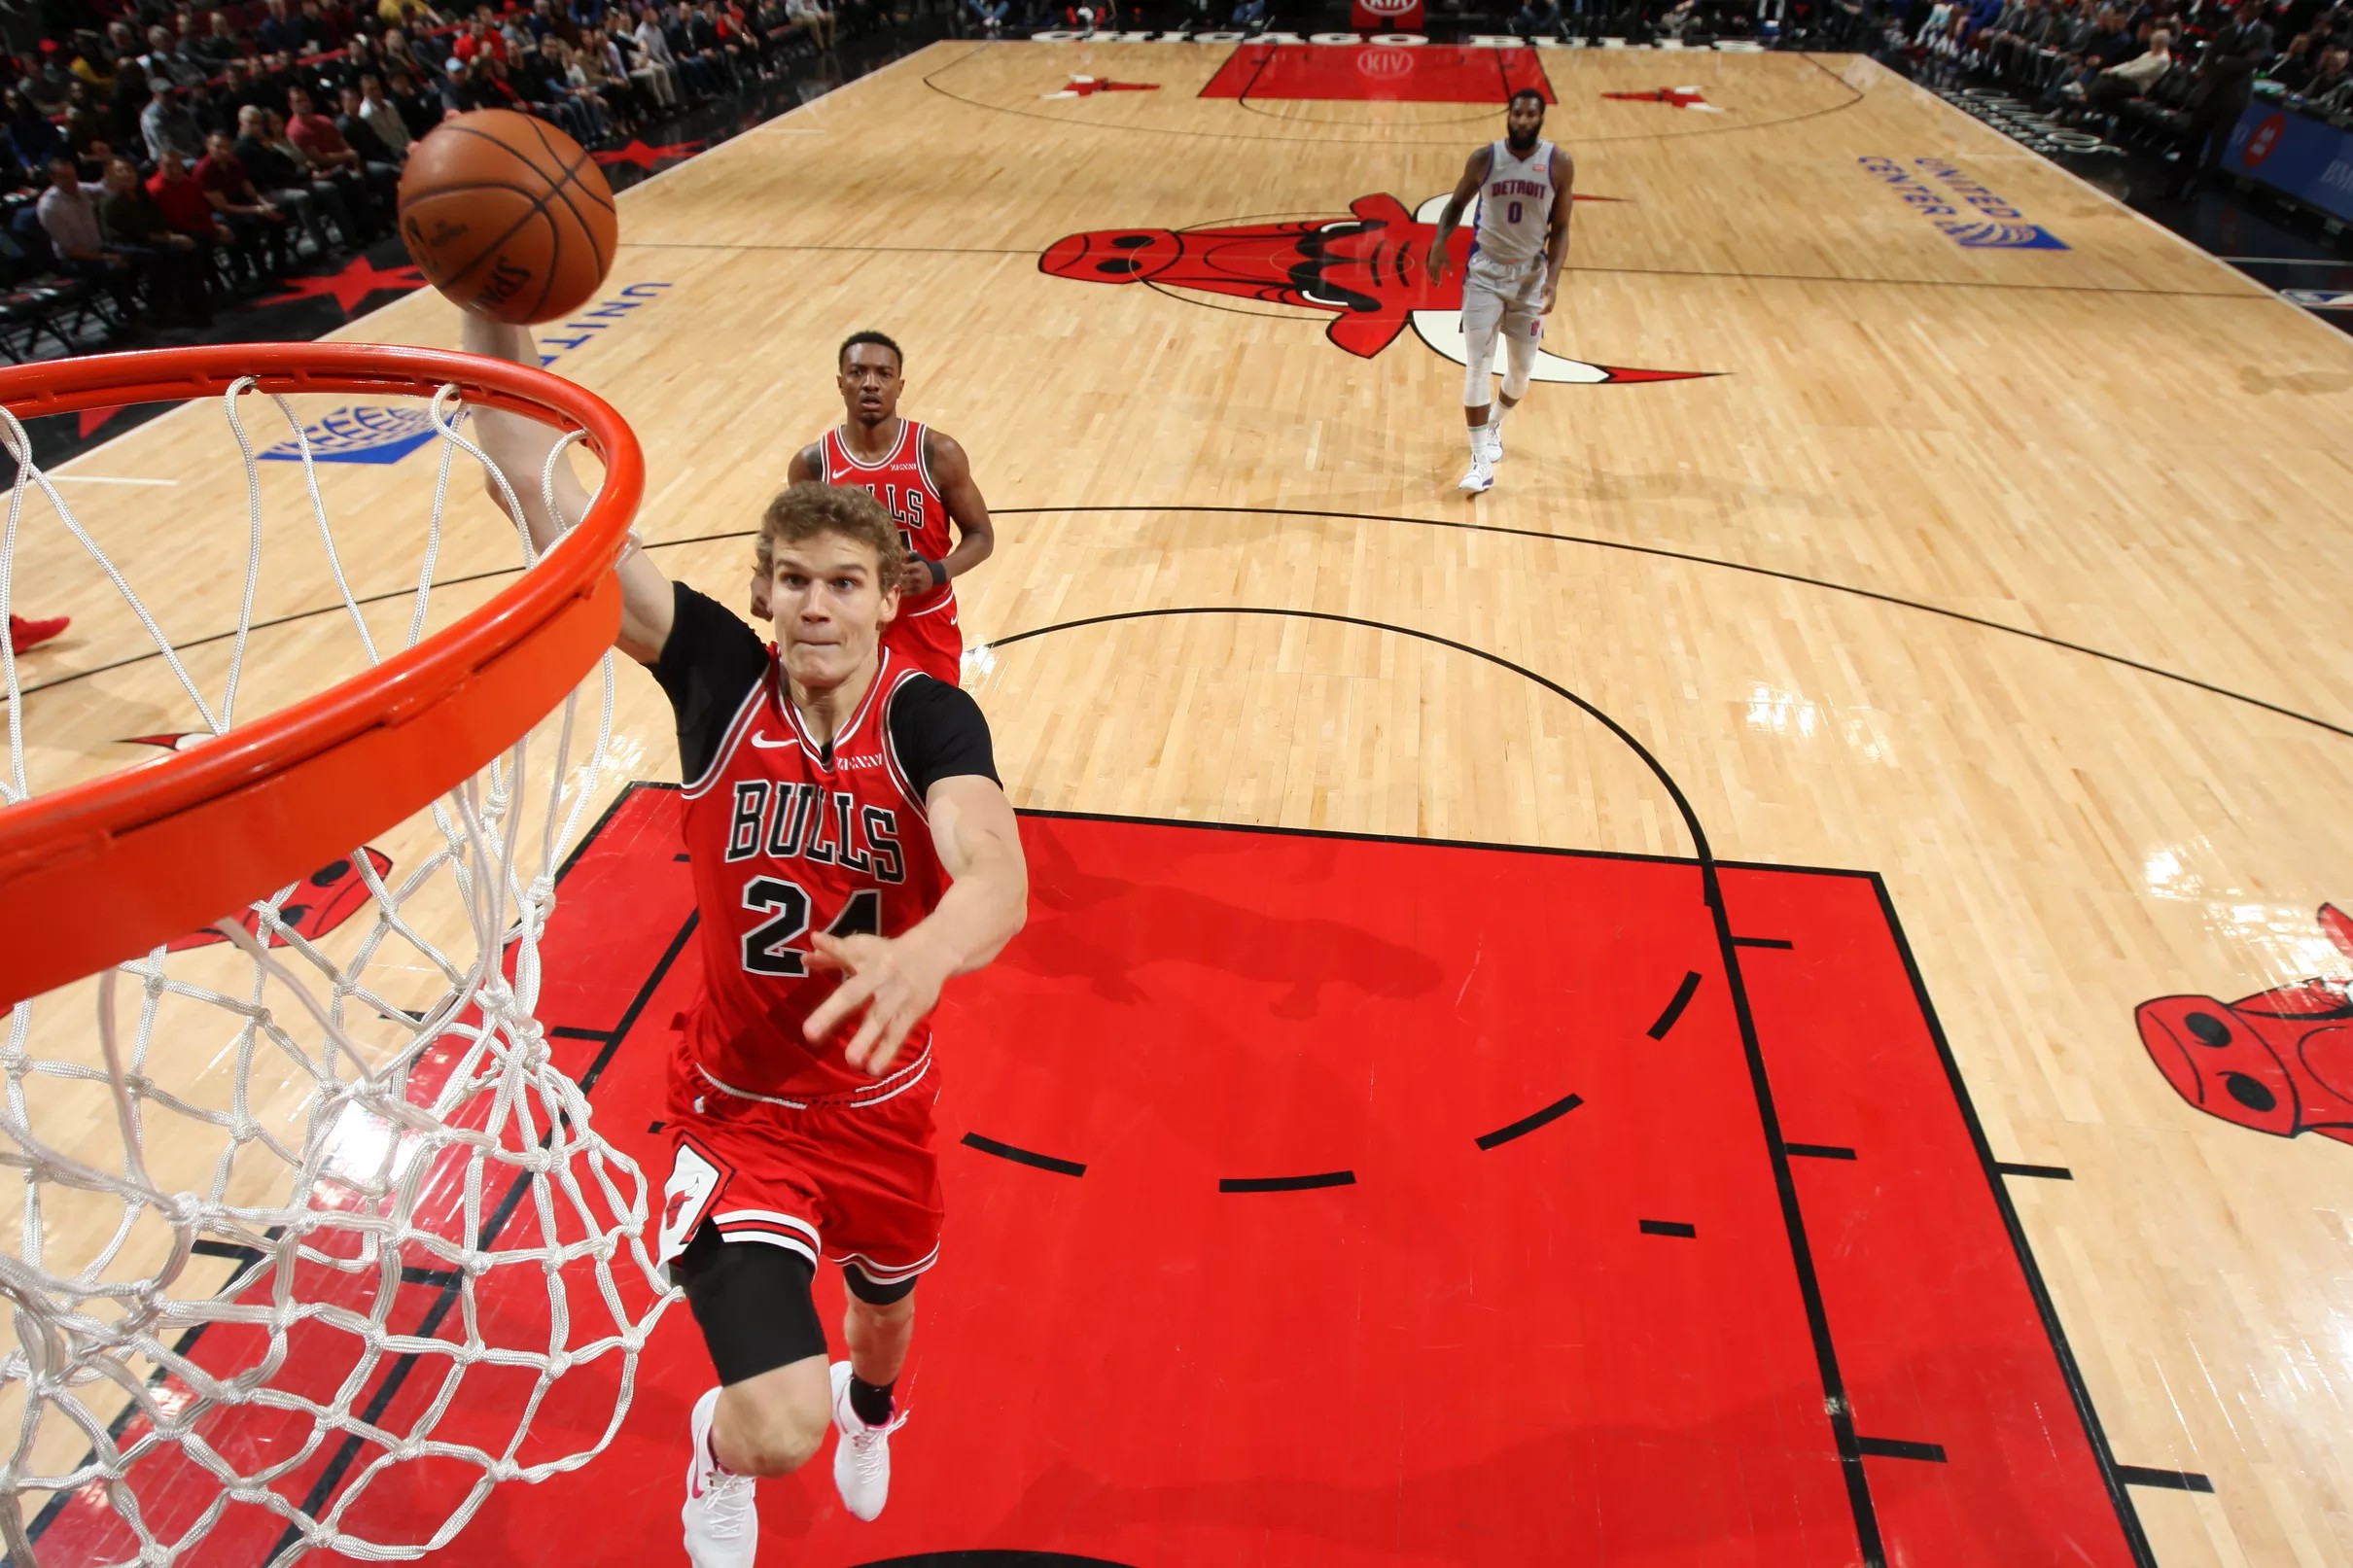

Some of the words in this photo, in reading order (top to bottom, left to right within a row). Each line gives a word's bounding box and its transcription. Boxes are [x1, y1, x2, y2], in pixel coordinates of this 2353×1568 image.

[1491, 179, 1547, 200] DETROIT
[1507, 200, 1523, 225] 0
[539, 283, 673, 366] UNIT
[725, 779, 906, 886] BULLS
